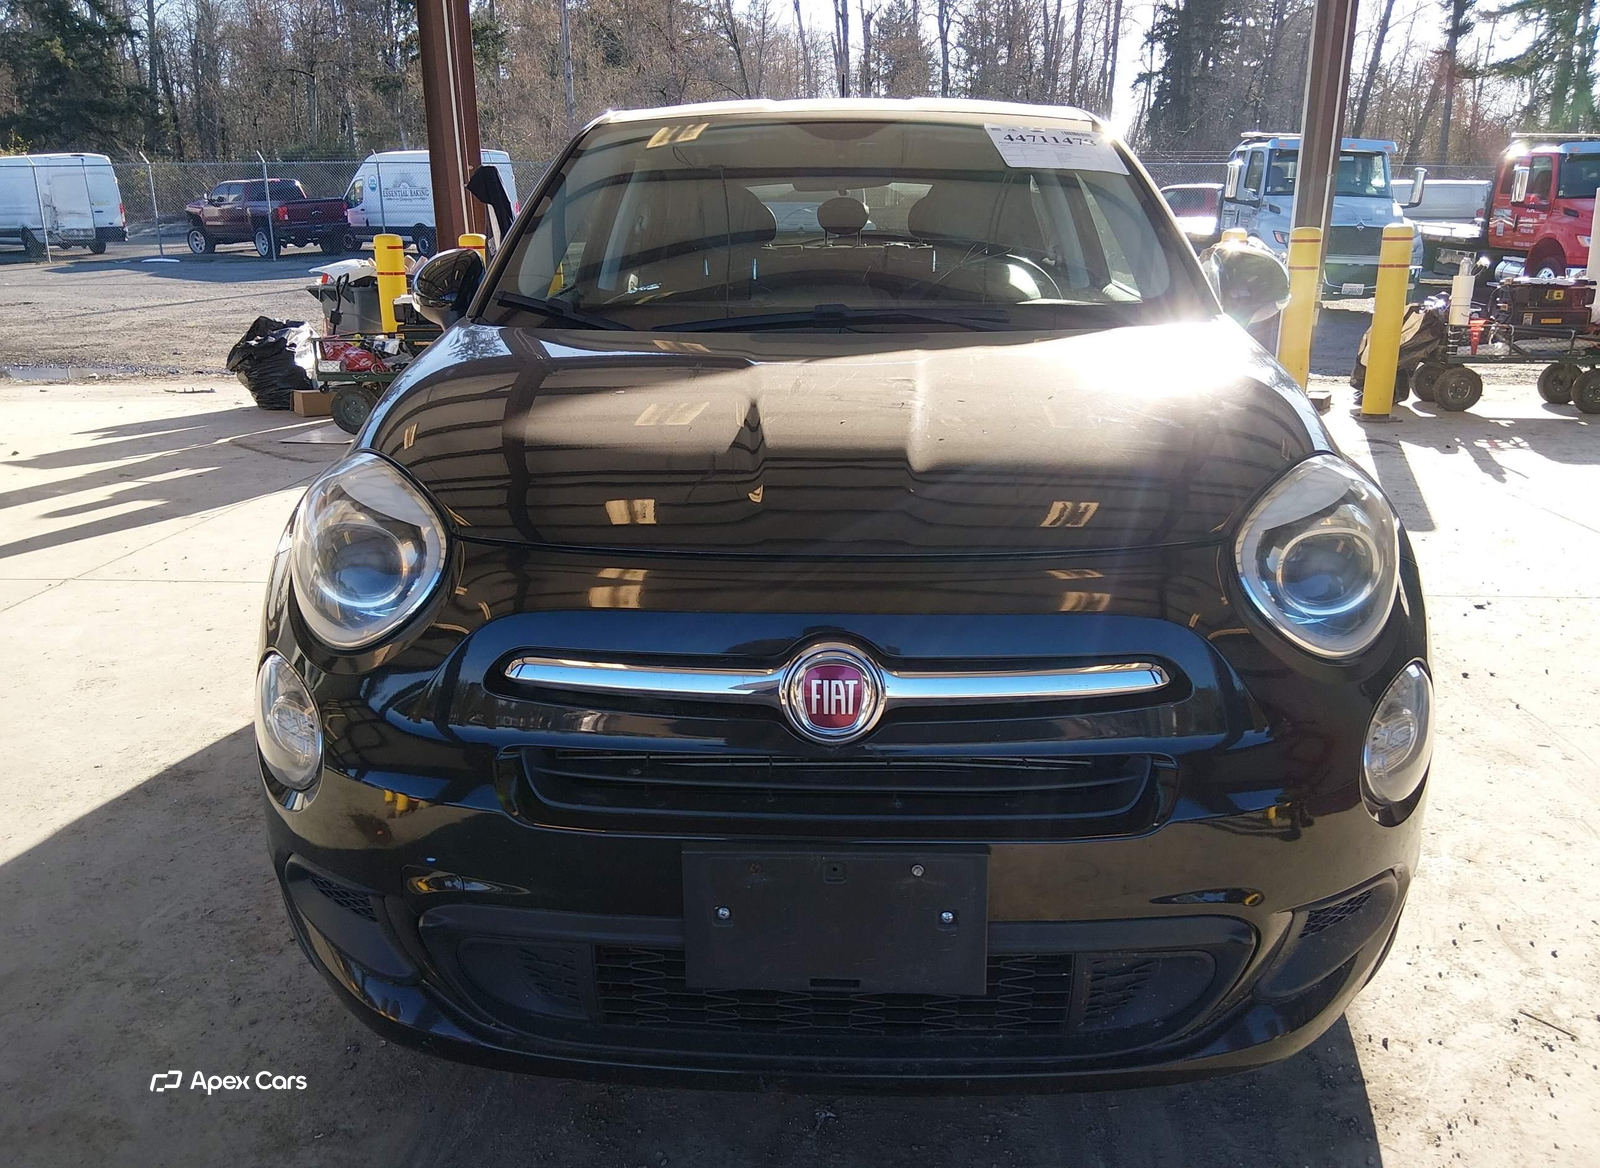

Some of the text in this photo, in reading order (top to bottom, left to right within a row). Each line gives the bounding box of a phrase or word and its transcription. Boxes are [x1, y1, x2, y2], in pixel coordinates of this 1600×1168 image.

[383, 189, 430, 198] ESSENTIAL BAKING
[811, 679, 859, 715] FIAT
